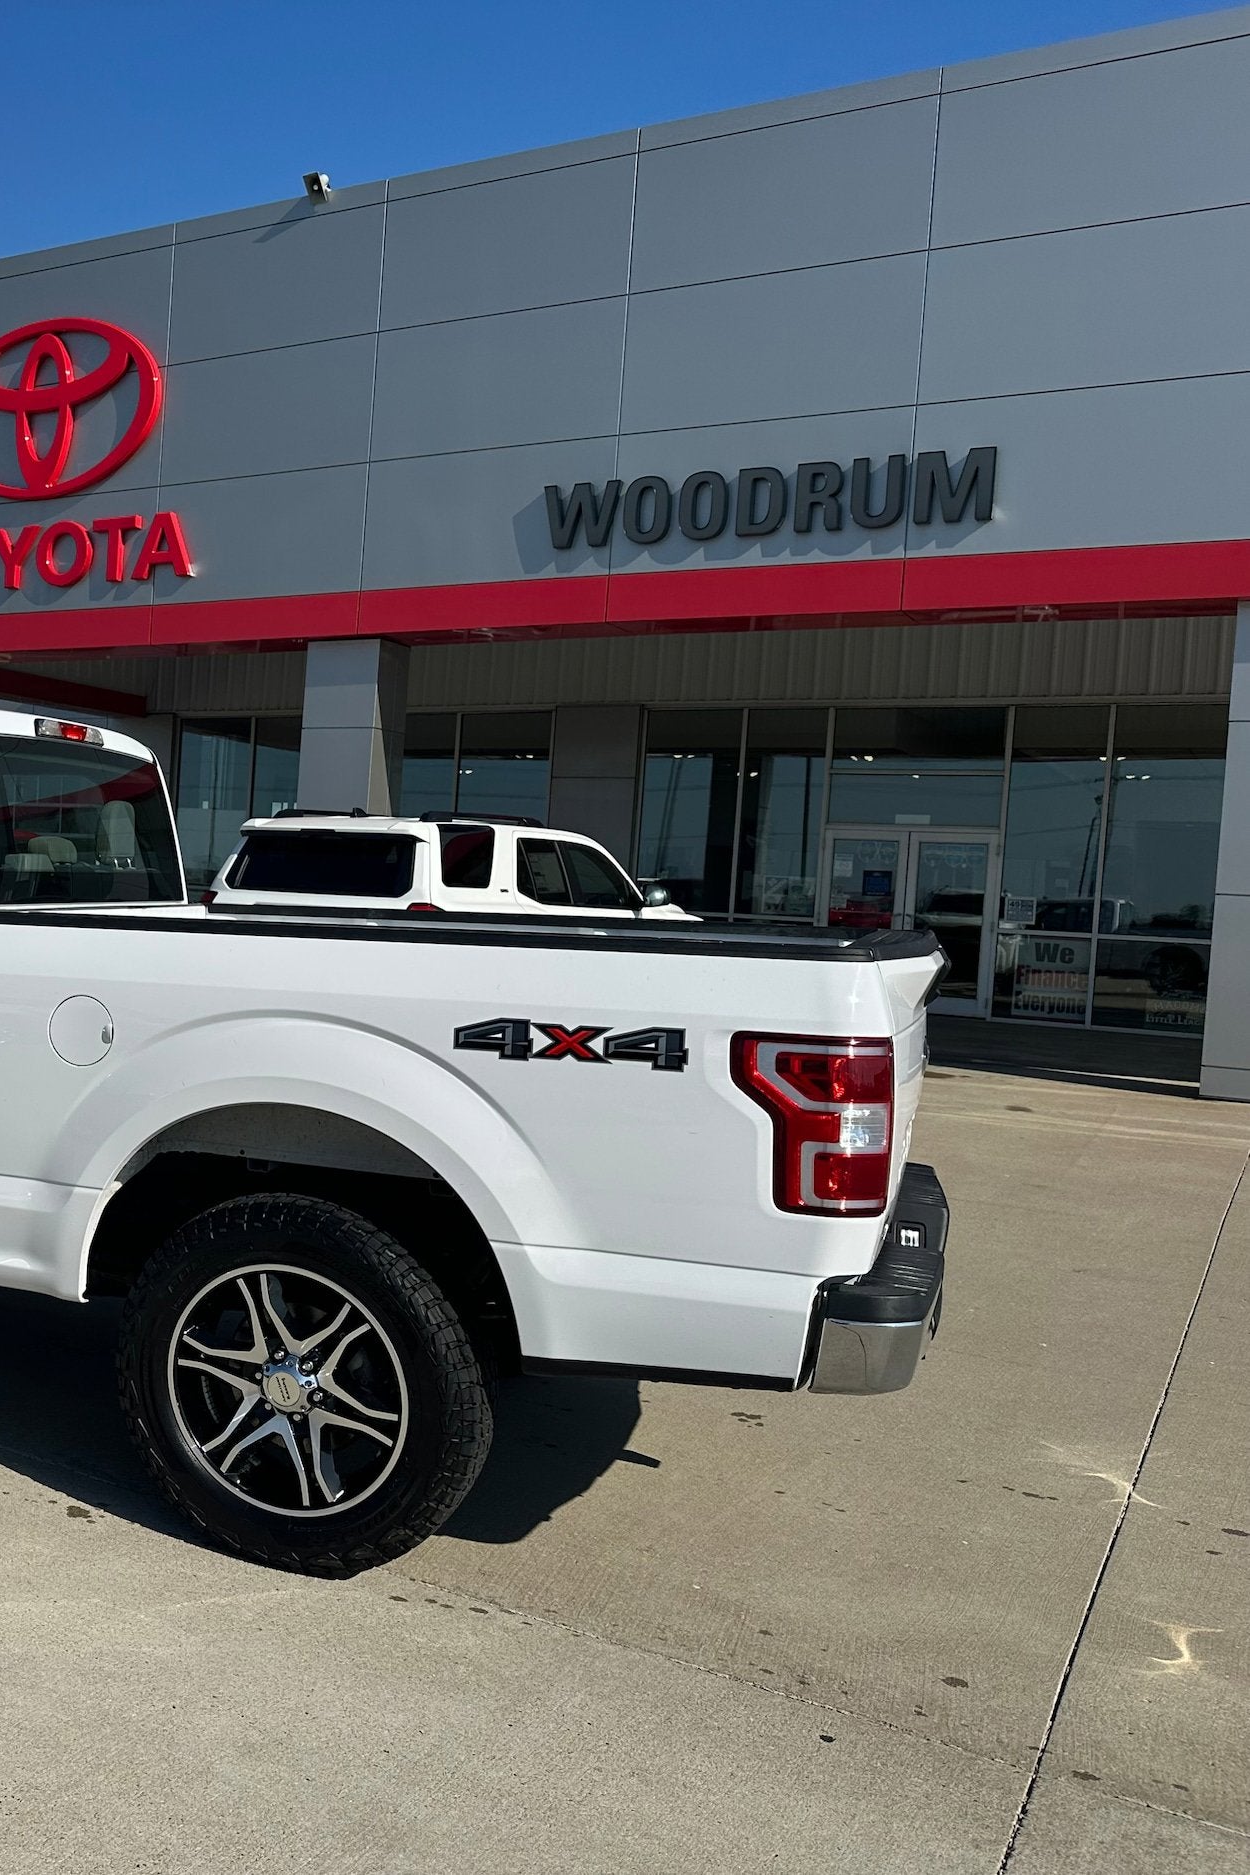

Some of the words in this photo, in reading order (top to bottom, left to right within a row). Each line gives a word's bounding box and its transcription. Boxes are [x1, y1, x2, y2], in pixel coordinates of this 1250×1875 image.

[544, 445, 998, 549] WOODRUM
[1034, 942, 1075, 964] We
[1015, 964, 1089, 990] Finance
[1013, 990, 1087, 1015] Everyone
